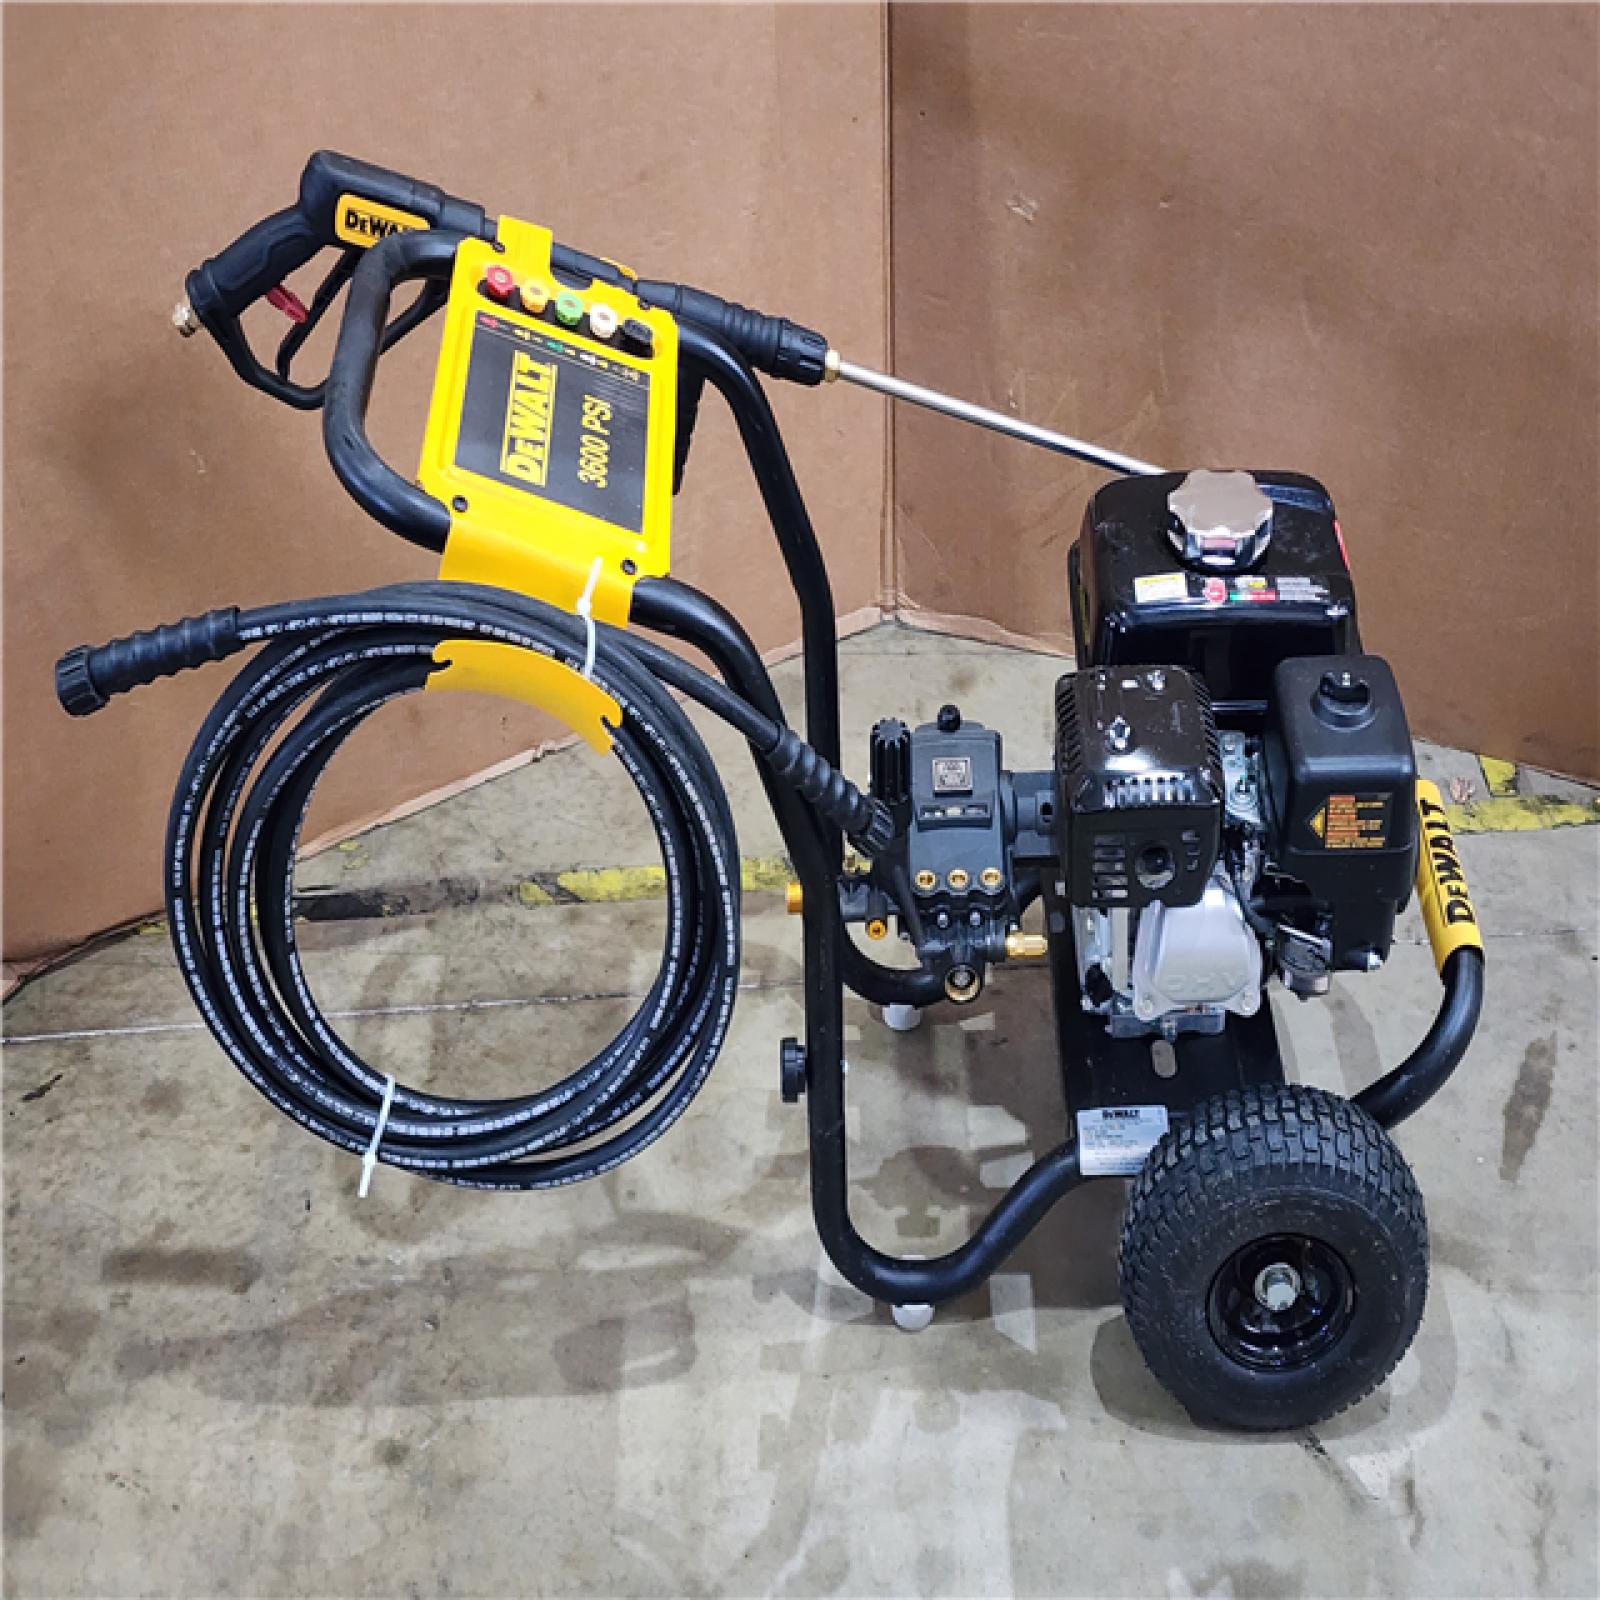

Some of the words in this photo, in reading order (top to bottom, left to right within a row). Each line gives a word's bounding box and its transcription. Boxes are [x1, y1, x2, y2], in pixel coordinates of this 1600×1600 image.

[503, 351, 554, 486] DEWALT
[581, 394, 612, 435] PSI
[577, 434, 609, 488] 3600
[1419, 798, 1476, 924] DEWALT
